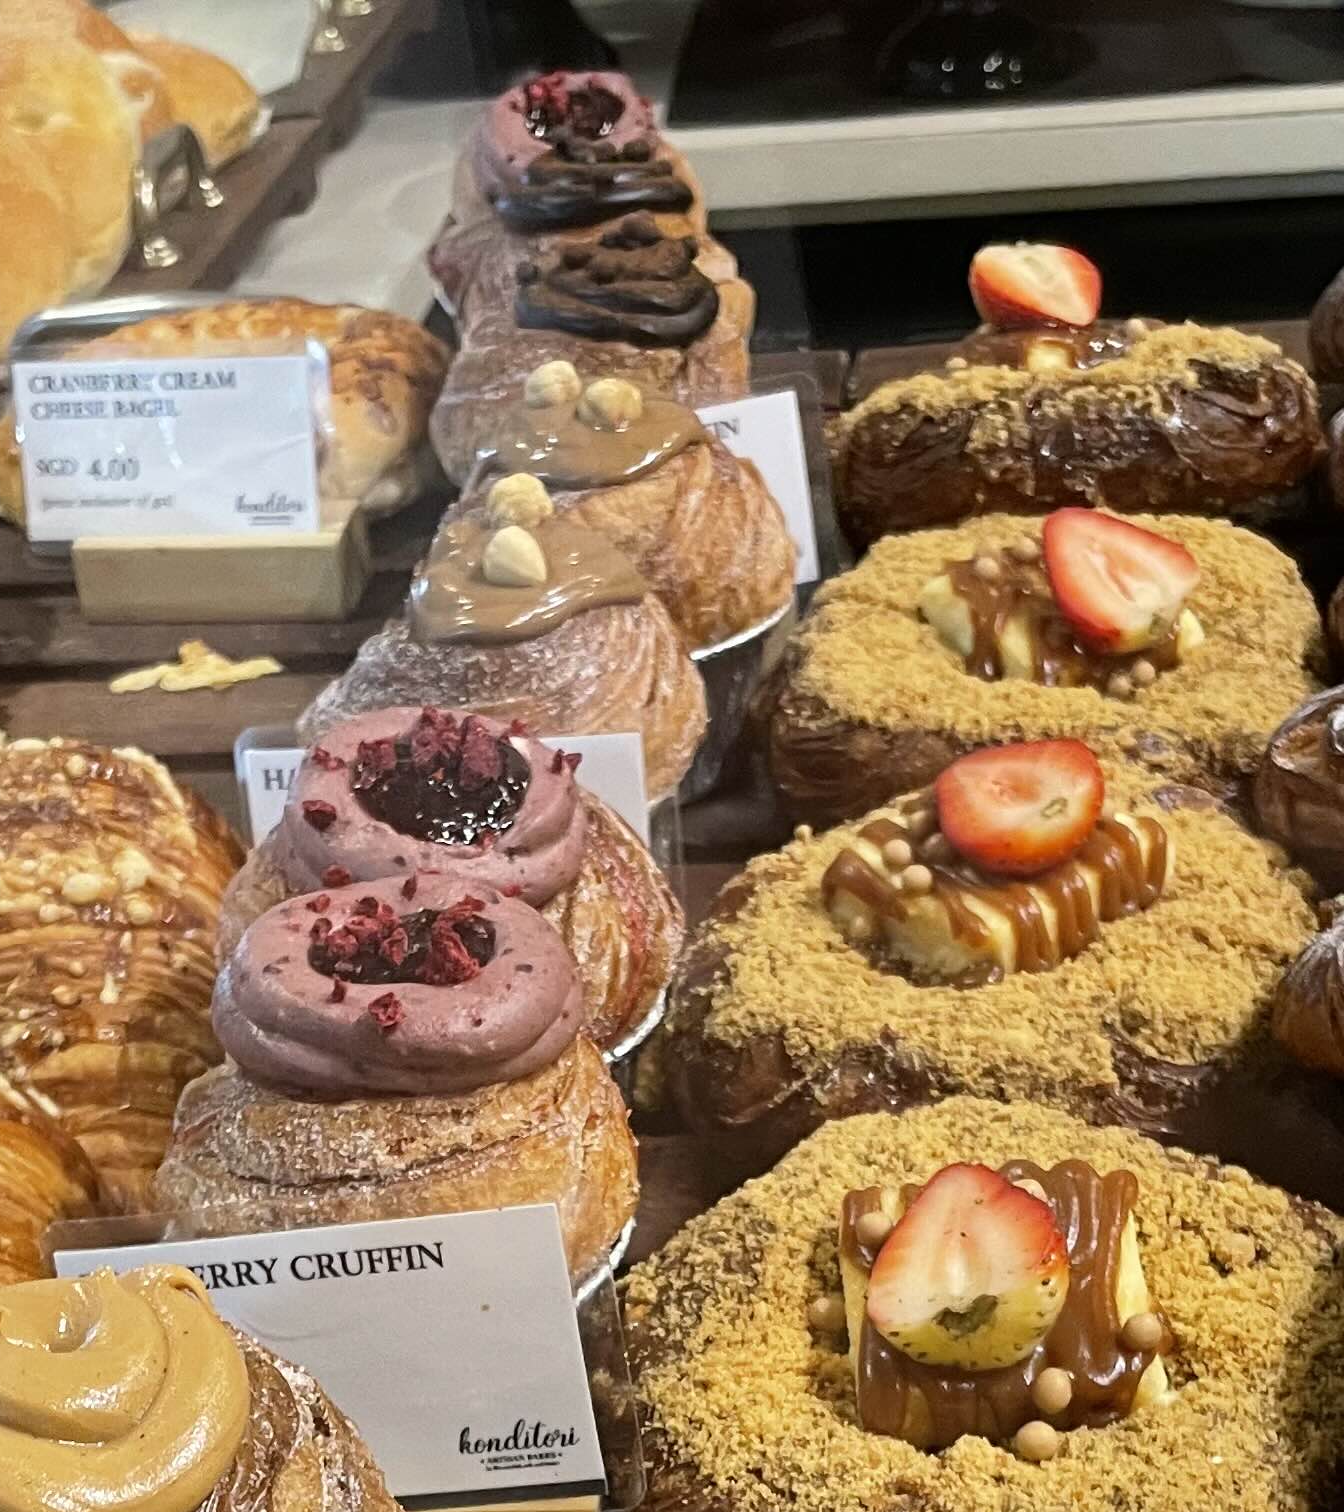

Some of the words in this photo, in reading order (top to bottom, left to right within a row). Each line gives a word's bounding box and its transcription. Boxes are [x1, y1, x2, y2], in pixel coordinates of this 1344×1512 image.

[159, 371, 236, 391] CREAM
[290, 1240, 446, 1282] CRUFFIN
[459, 1418, 580, 1454] konditori
